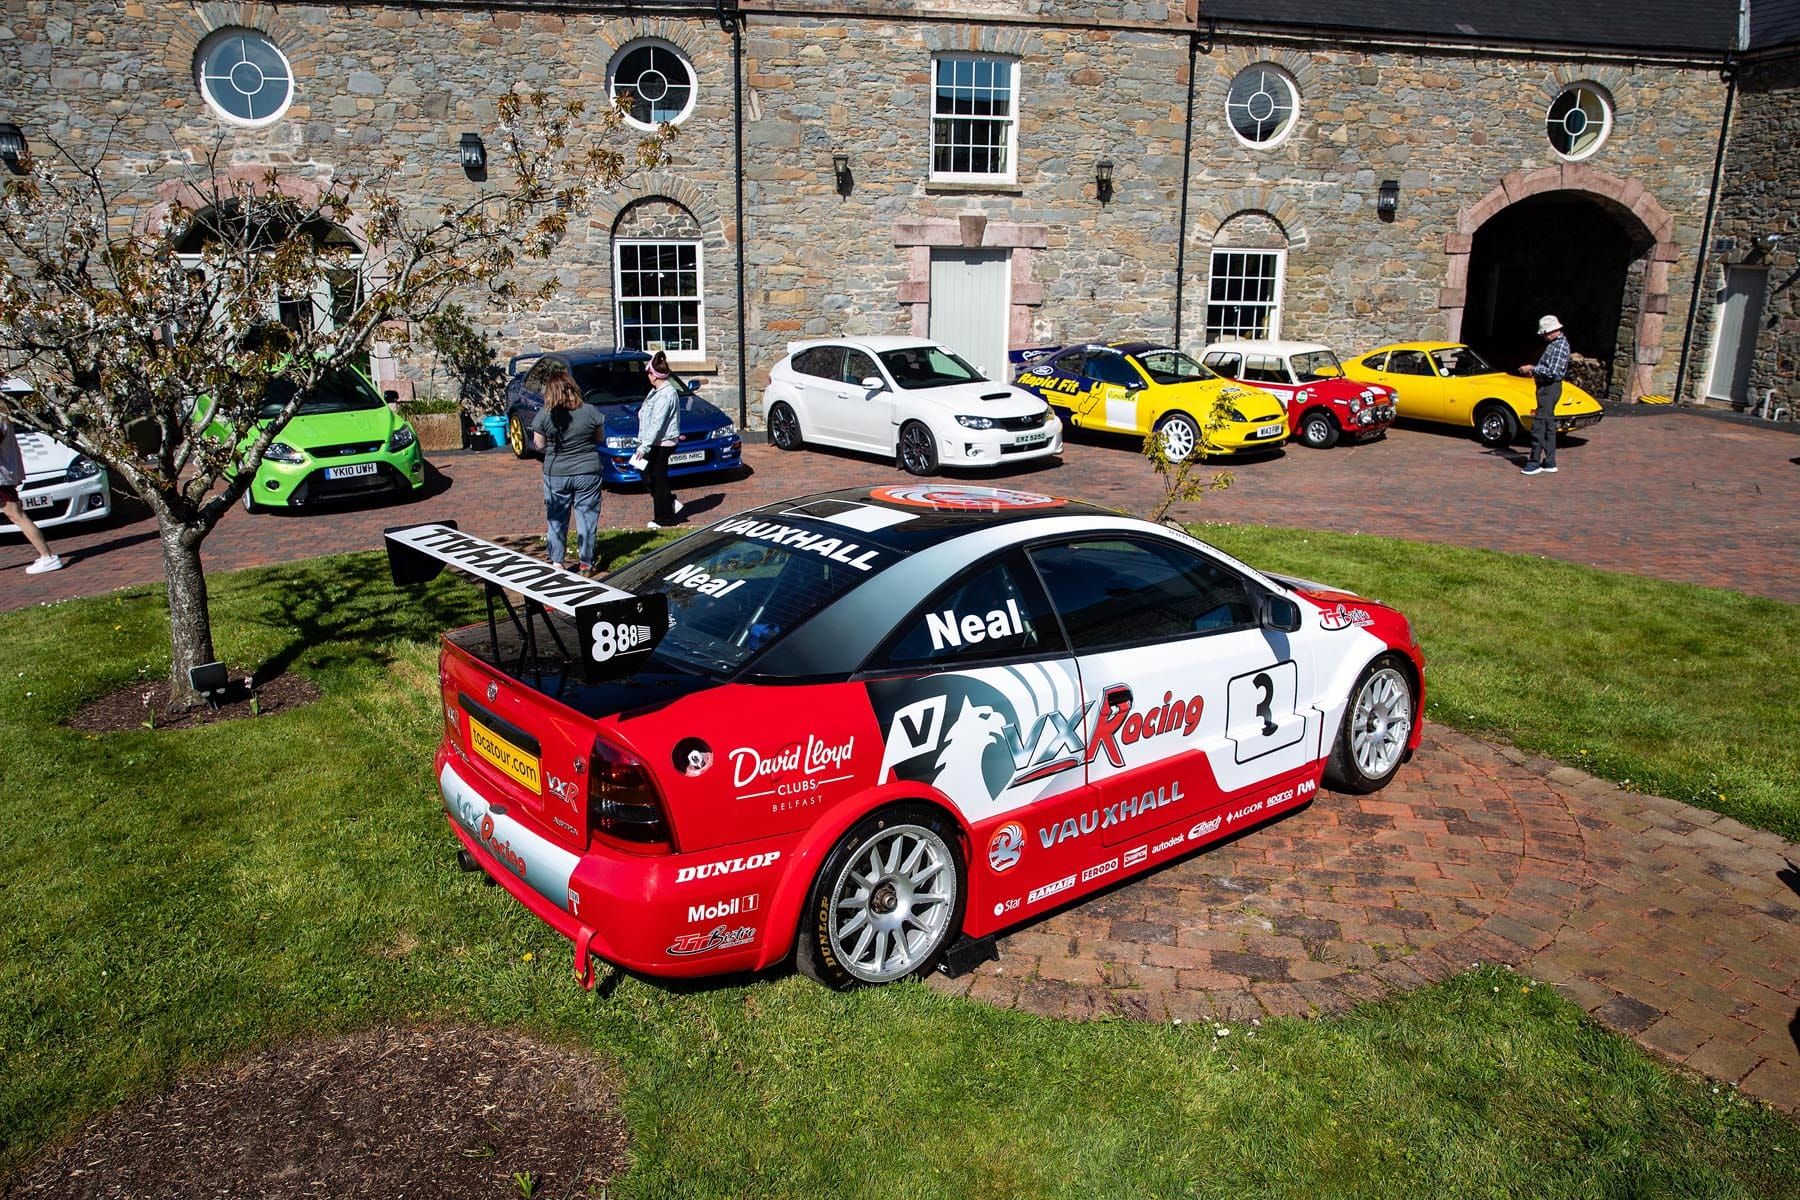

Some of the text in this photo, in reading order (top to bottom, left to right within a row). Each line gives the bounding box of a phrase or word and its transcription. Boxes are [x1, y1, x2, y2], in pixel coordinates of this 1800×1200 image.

[1017, 373, 1080, 393] Rapid Fit
[333, 464, 374, 477] YK10 UWH
[25, 495, 49, 508] HLR
[411, 528, 610, 607] VAUXHALL
[713, 519, 880, 572] VAUXHALL
[663, 563, 746, 599] Neal
[926, 599, 1024, 651] Neal
[1253, 672, 1280, 737] 3
[472, 728, 537, 783] tocatour.com
[729, 734, 855, 788] David Lloyd
[772, 795, 822, 812] BELFAST
[777, 779, 816, 796] CLUBS
[1039, 780, 1185, 849] VAUXHALL
[1004, 897, 1022, 912] Star
[1028, 875, 1077, 903] RAMAIR
[1083, 860, 1118, 881] FERODO
[1152, 832, 1185, 854] autodesk
[1233, 801, 1263, 821] ALGOR
[1265, 789, 1294, 808] sparco
[1297, 778, 1316, 796] RM
[675, 851, 781, 884] DUNLOP
[687, 897, 740, 923] Mobil
